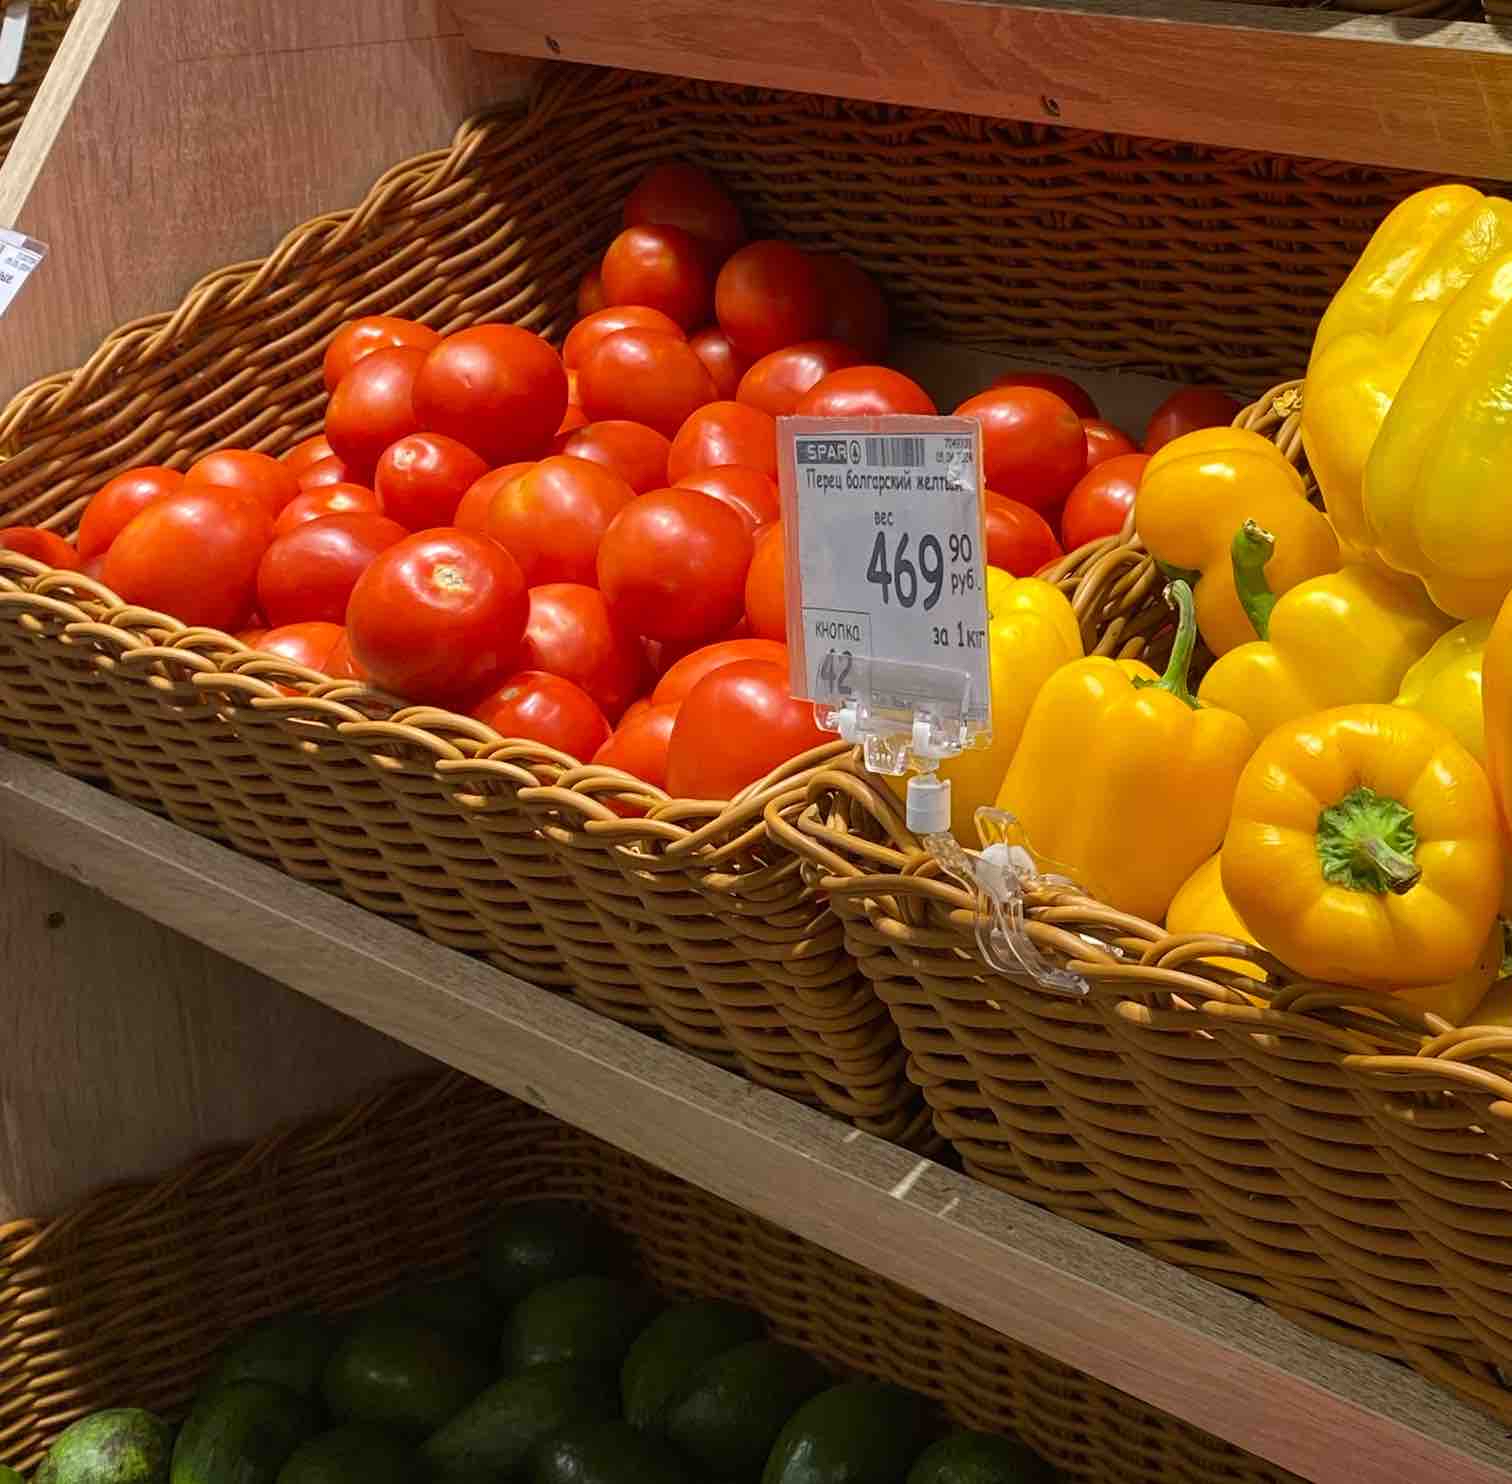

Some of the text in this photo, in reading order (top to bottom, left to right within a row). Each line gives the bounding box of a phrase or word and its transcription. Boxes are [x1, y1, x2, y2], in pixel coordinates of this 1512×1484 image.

[806, 444, 848, 461] SPAR
[806, 468, 843, 493] Перец
[846, 470, 912, 496] болгарский
[874, 511, 894, 526] вес
[949, 533, 972, 563] 90
[866, 531, 944, 611] 469
[951, 568, 982, 595] руб.
[815, 621, 860, 641] кнопка
[932, 627, 949, 646] за
[821, 649, 853, 695] 42
